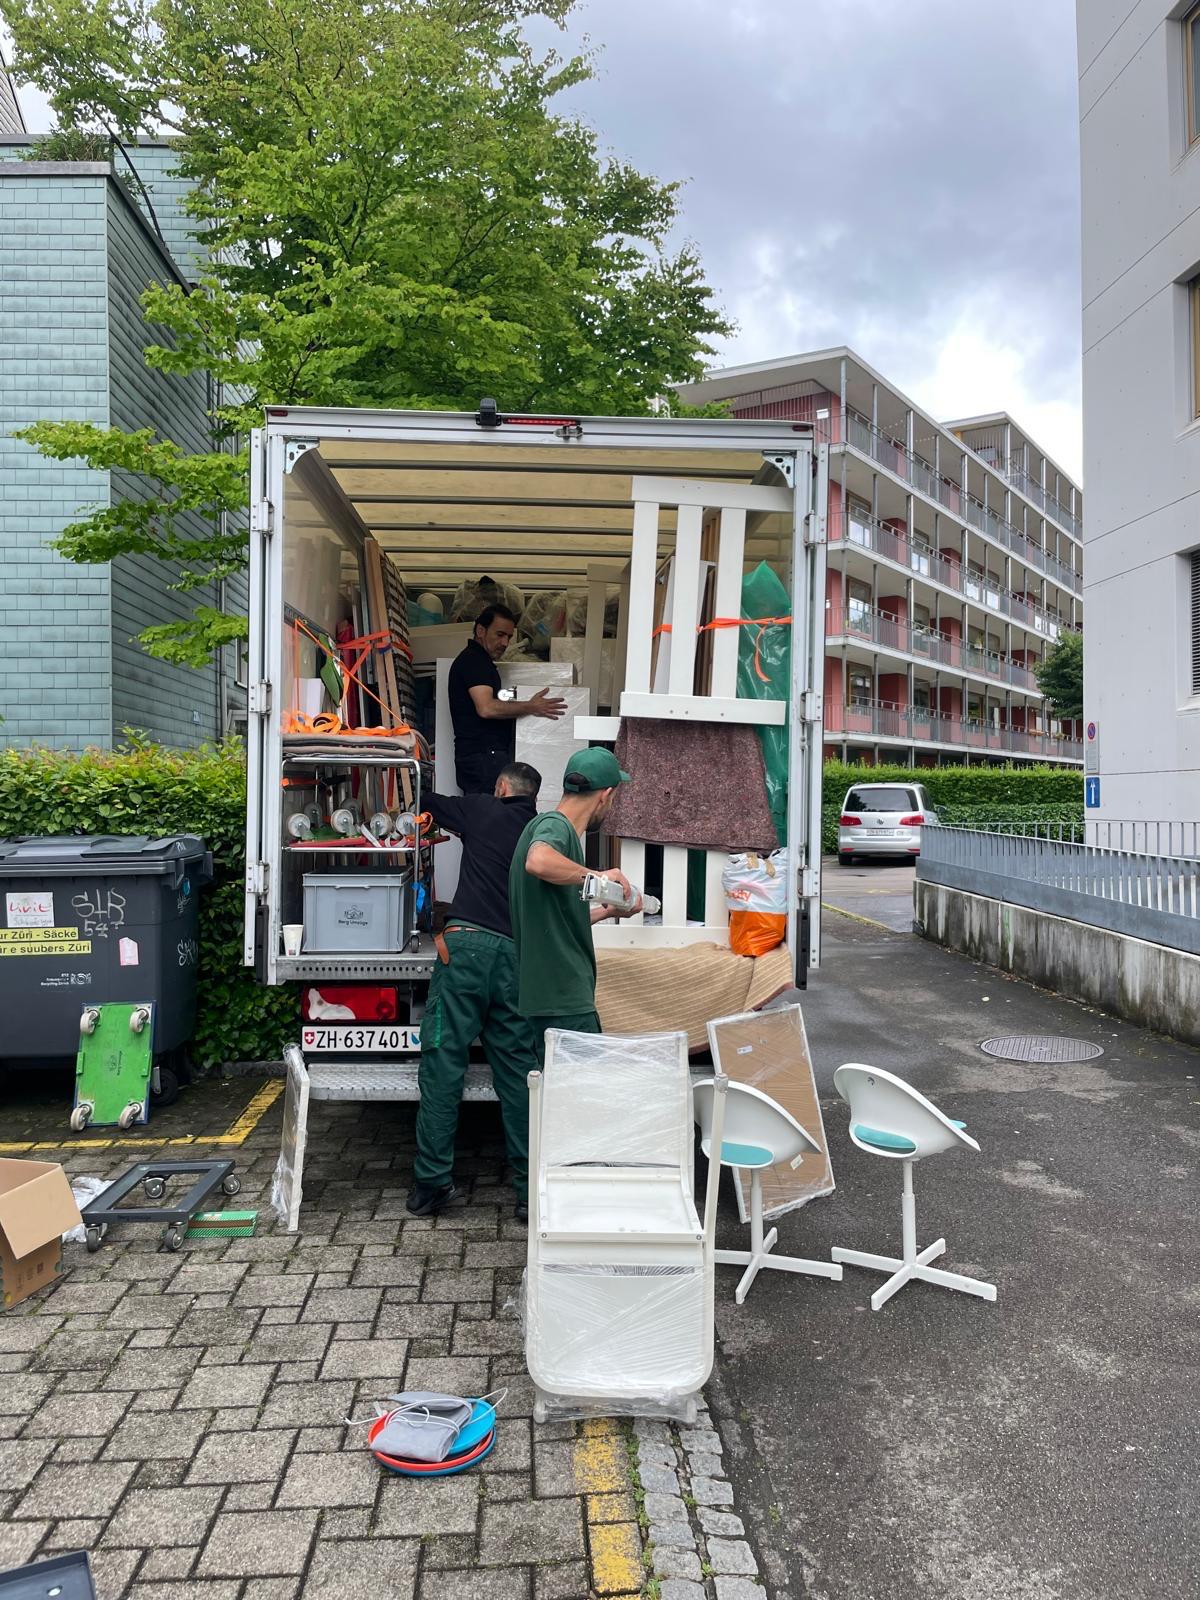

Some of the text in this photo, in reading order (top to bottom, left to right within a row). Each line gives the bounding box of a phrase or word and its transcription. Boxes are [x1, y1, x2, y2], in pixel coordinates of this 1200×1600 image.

[11, 930, 33, 940] Züri
[43, 929, 77, 939] Säcke
[10, 946, 17, 954] e
[20, 944, 65, 954] suubers
[68, 943, 90, 952] Züri
